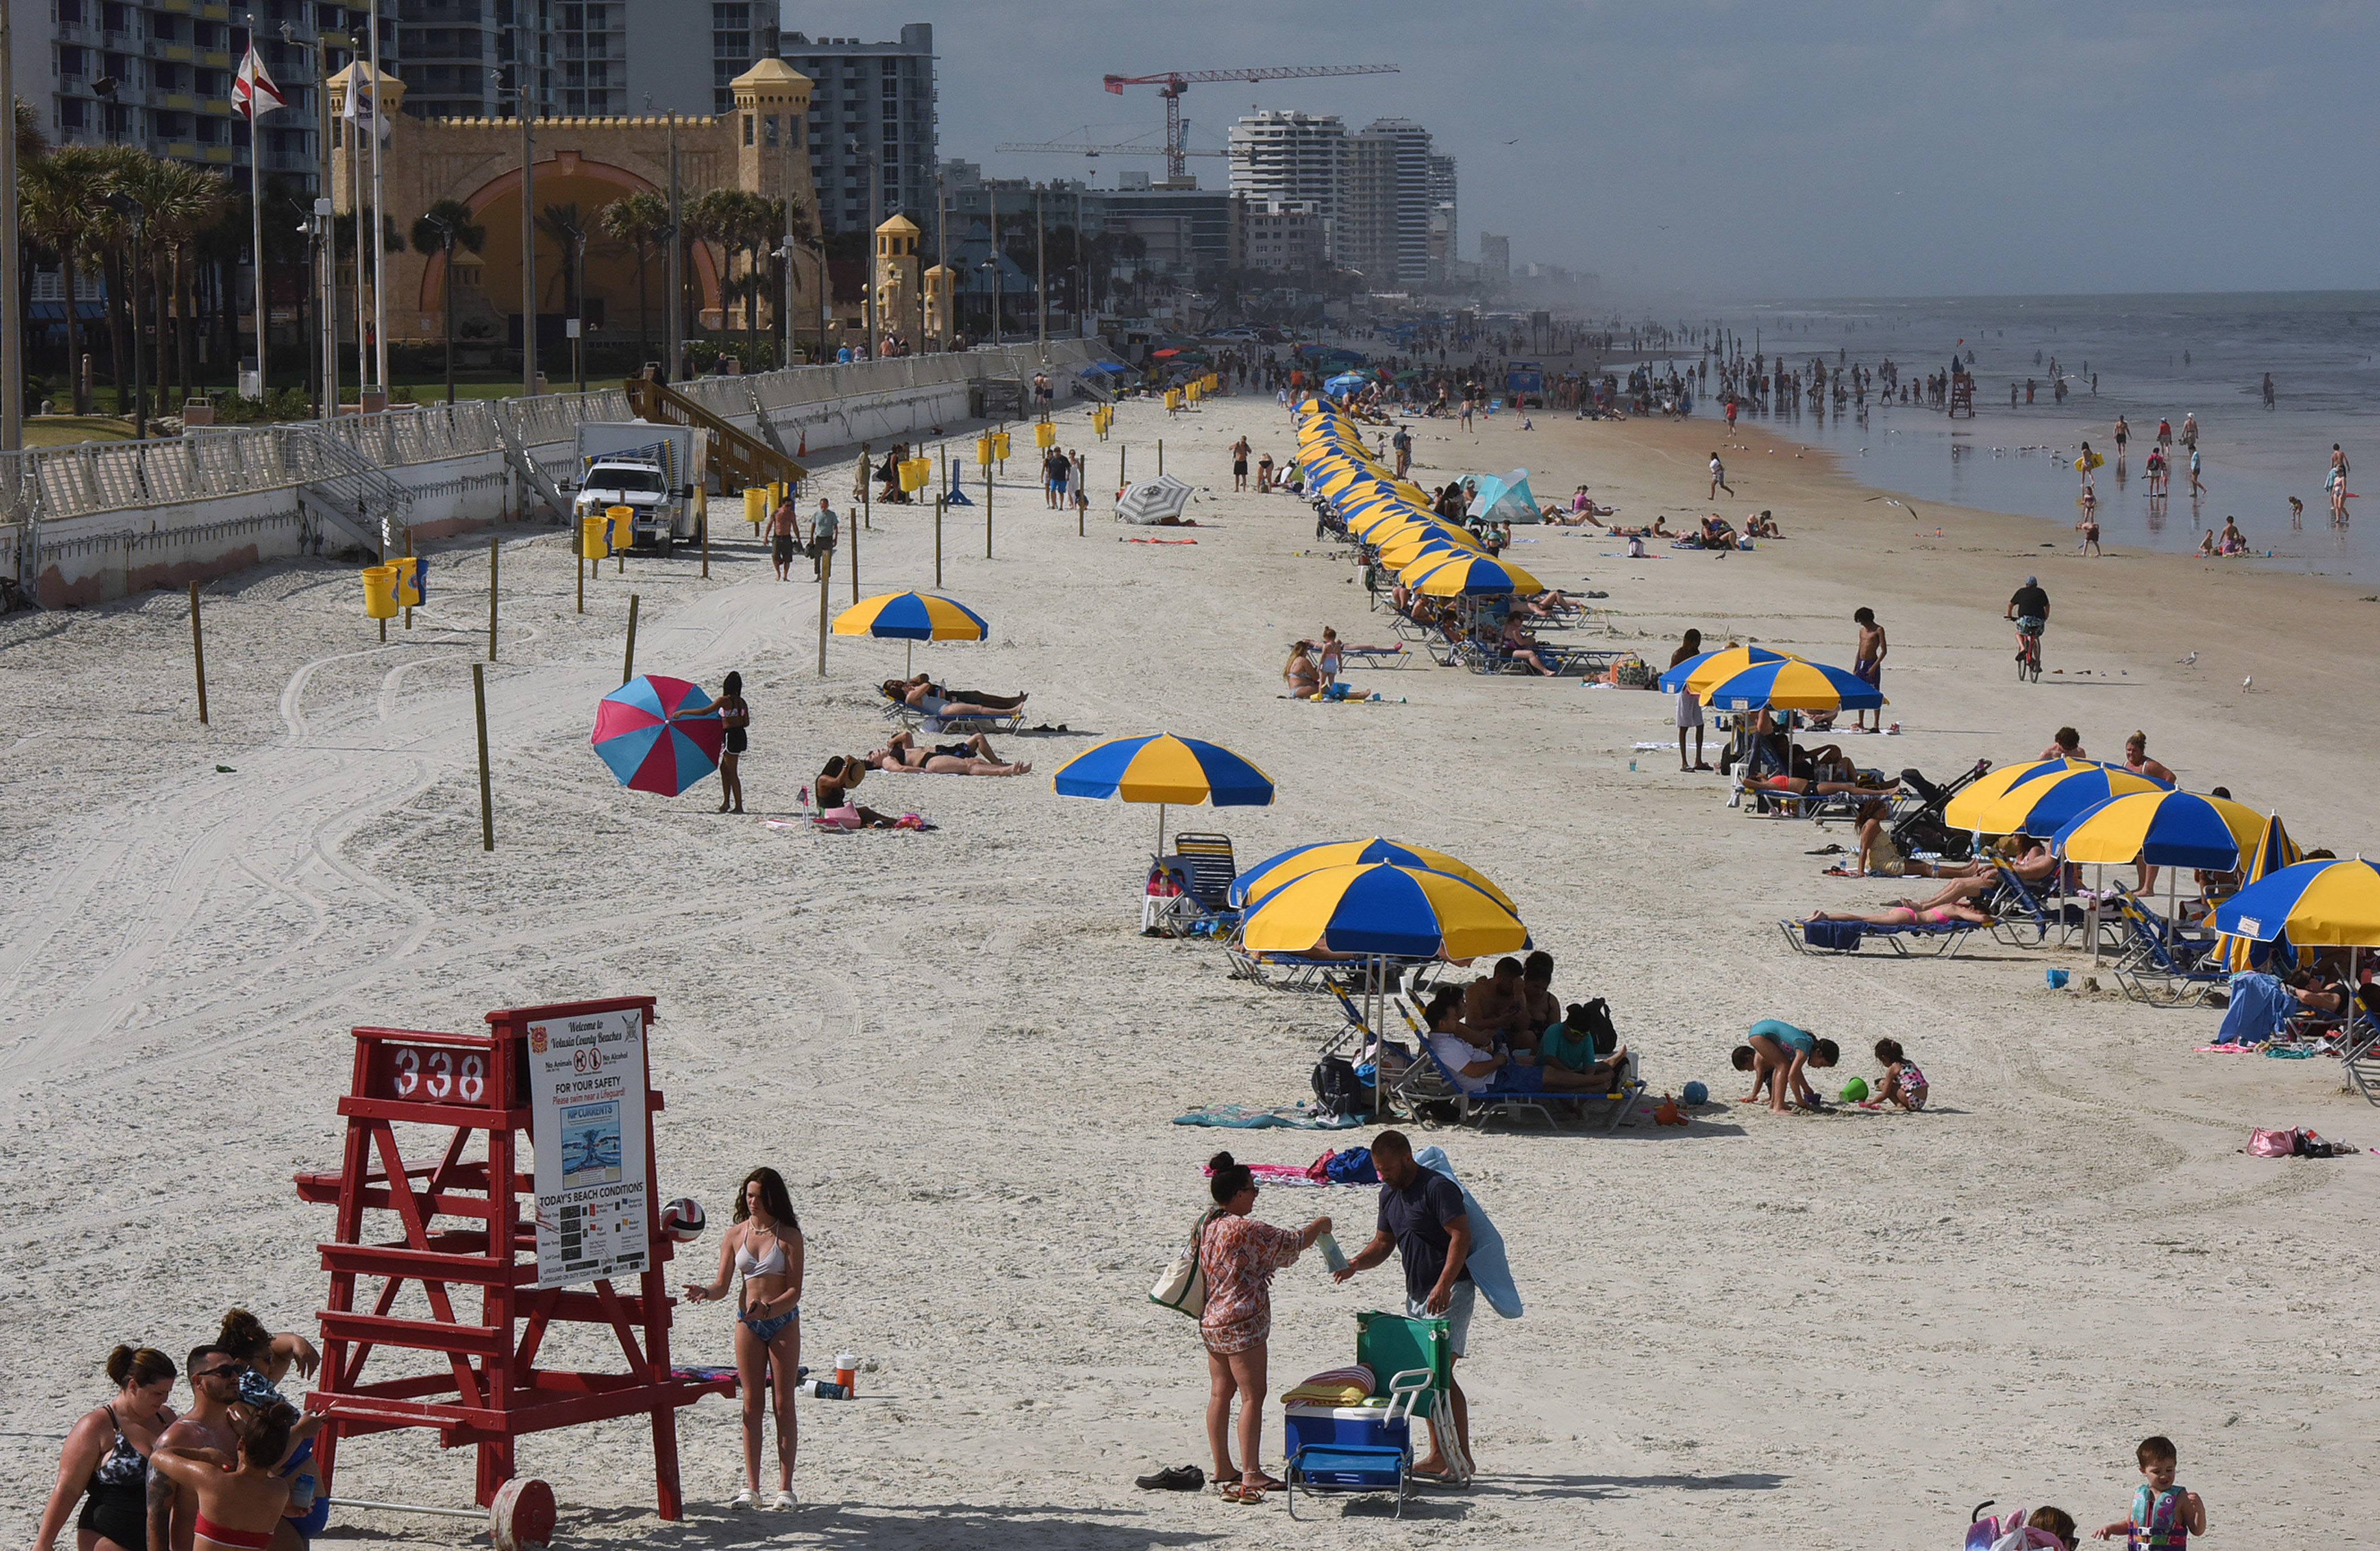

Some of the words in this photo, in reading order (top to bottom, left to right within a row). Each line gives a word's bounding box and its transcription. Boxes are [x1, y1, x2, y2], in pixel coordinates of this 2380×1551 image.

[568, 1021, 596, 1032] Welcome
[597, 1020, 604, 1030] to
[551, 1036, 575, 1048] Volusia
[576, 1034, 597, 1047] County
[597, 1031, 622, 1043] Beaches
[554, 1059, 572, 1068] Animals
[611, 1051, 628, 1061] Alcohol
[394, 1048, 484, 1102] 338
[556, 1083, 571, 1094] FOR
[572, 1080, 593, 1091] YOUR
[594, 1076, 621, 1089] SAFETY
[552, 1096, 569, 1104] Please
[570, 1093, 583, 1102] swim
[601, 1087, 625, 1100] Lifeguard!
[578, 1105, 613, 1118] CURRENTS
[539, 1193, 572, 1207] TODAY'S
[573, 1190, 598, 1202] BEACH
[600, 1182, 643, 1197] CONDITIONS
[542, 1274, 562, 1284] LIFEGUARD
